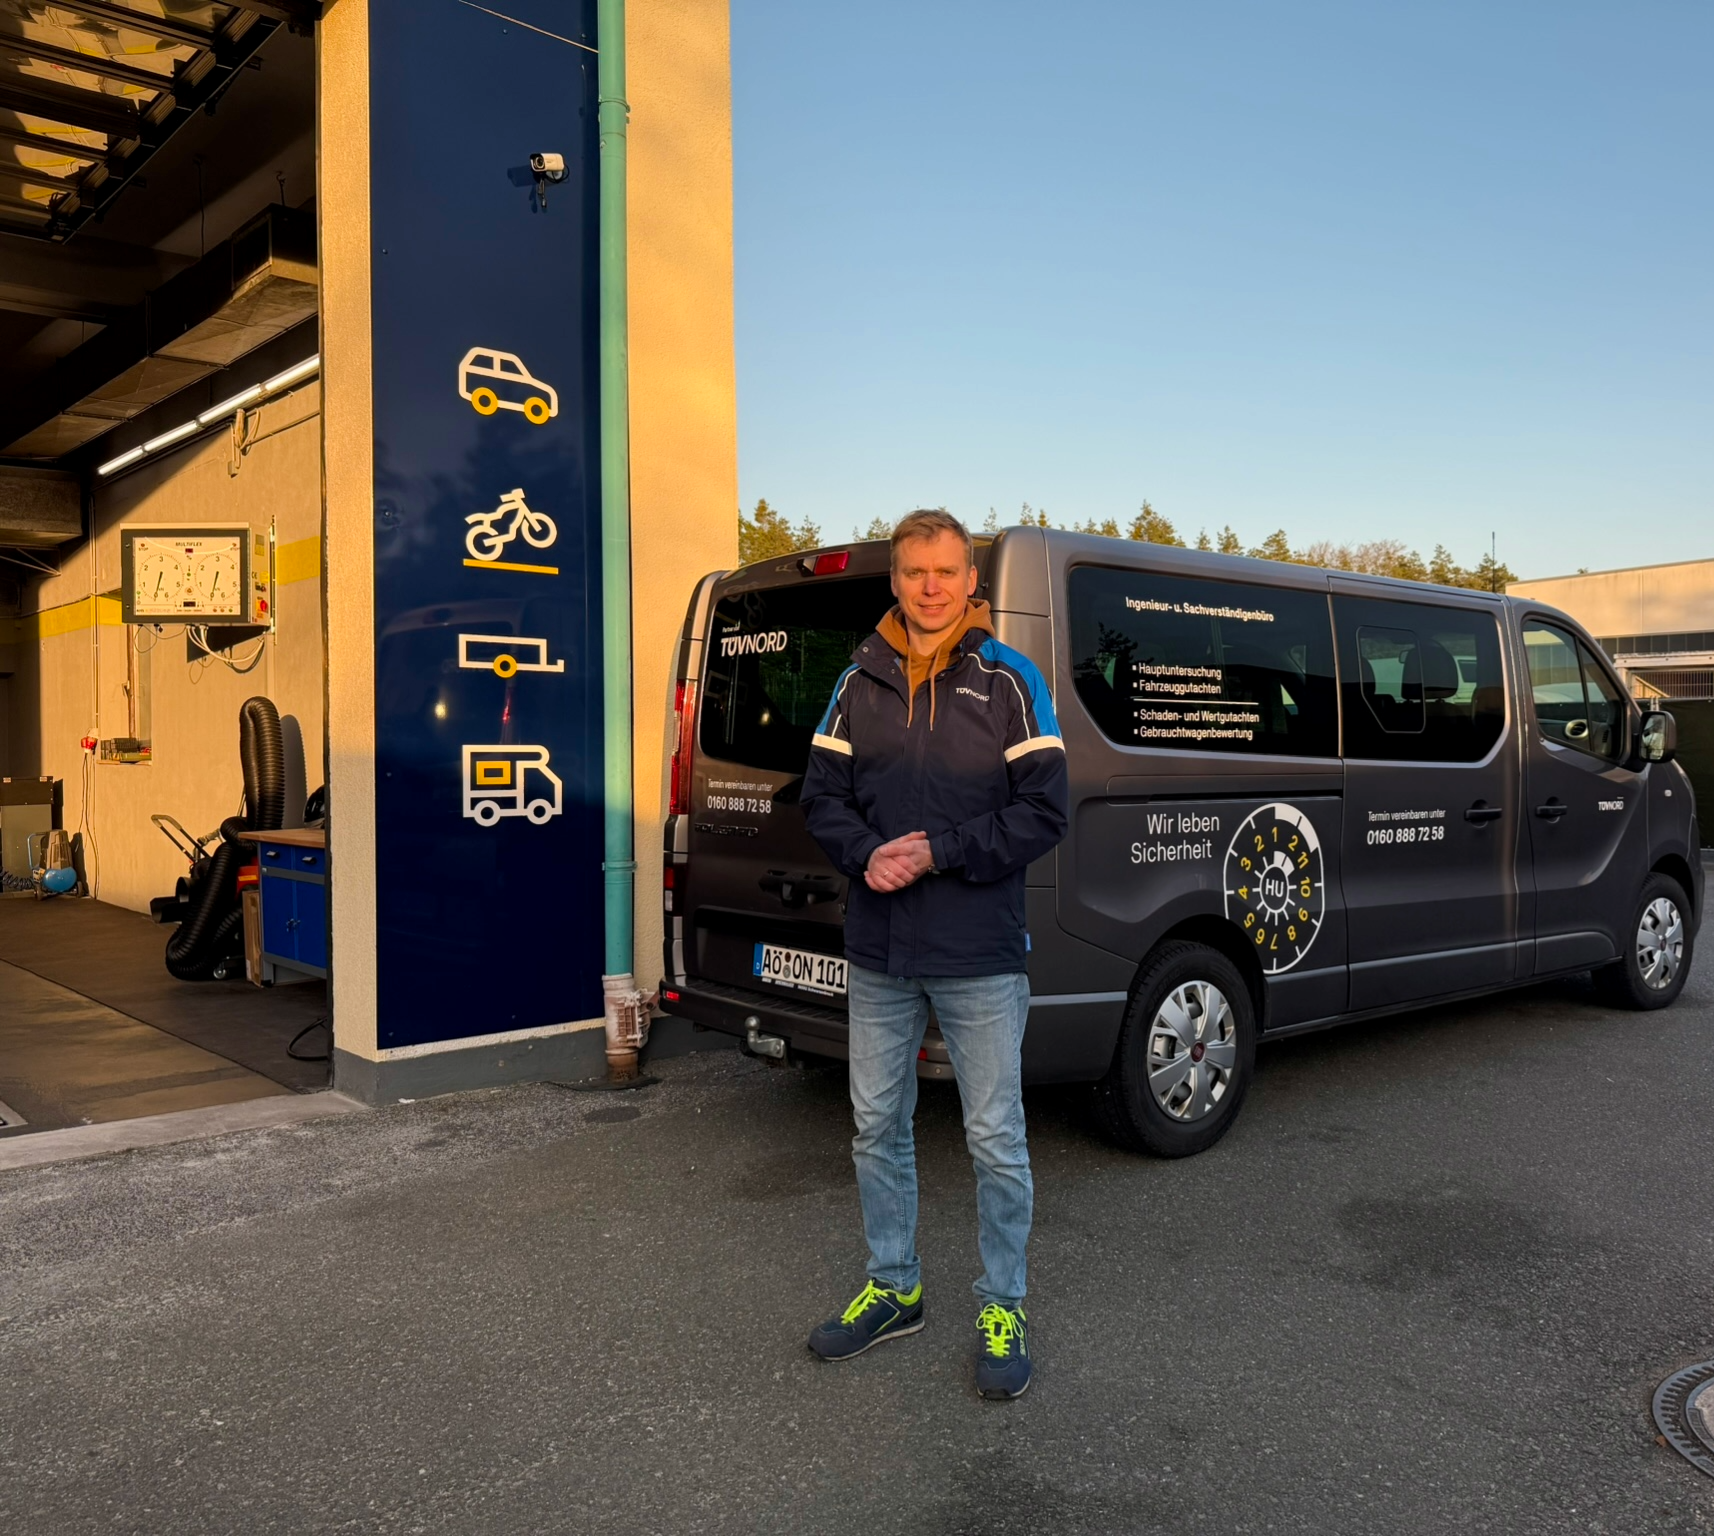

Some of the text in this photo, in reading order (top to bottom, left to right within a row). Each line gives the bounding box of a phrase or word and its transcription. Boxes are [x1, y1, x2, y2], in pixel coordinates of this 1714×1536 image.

[1125, 596, 1275, 622] Ingenieur- u. Sachverständigenbüro
[1138, 662, 1222, 680] Hauptuntersuchung
[1139, 679, 1222, 696] Fahrzeuggutachten
[1140, 708, 1260, 724] Schaden- und Wertgutachten
[1140, 725, 1253, 741] Gebrauchtwagenbewertung
[708, 778, 773, 791] Termin vereinbaren unter
[707, 795, 771, 814] 0160 888 72 58
[1368, 808, 1446, 821] Termin vereinbaren unter
[1146, 812, 1220, 835] Wir leben
[1366, 825, 1444, 845] 0160 888 72 58
[1130, 838, 1212, 864] Sicherheit
[1240, 857, 1252, 871] 3
[1238, 885, 1248, 900] 4
[1265, 878, 1284, 898] HU
[1287, 925, 1296, 941] 8
[792, 953, 814, 982] ON
[816, 958, 846, 989] 101
